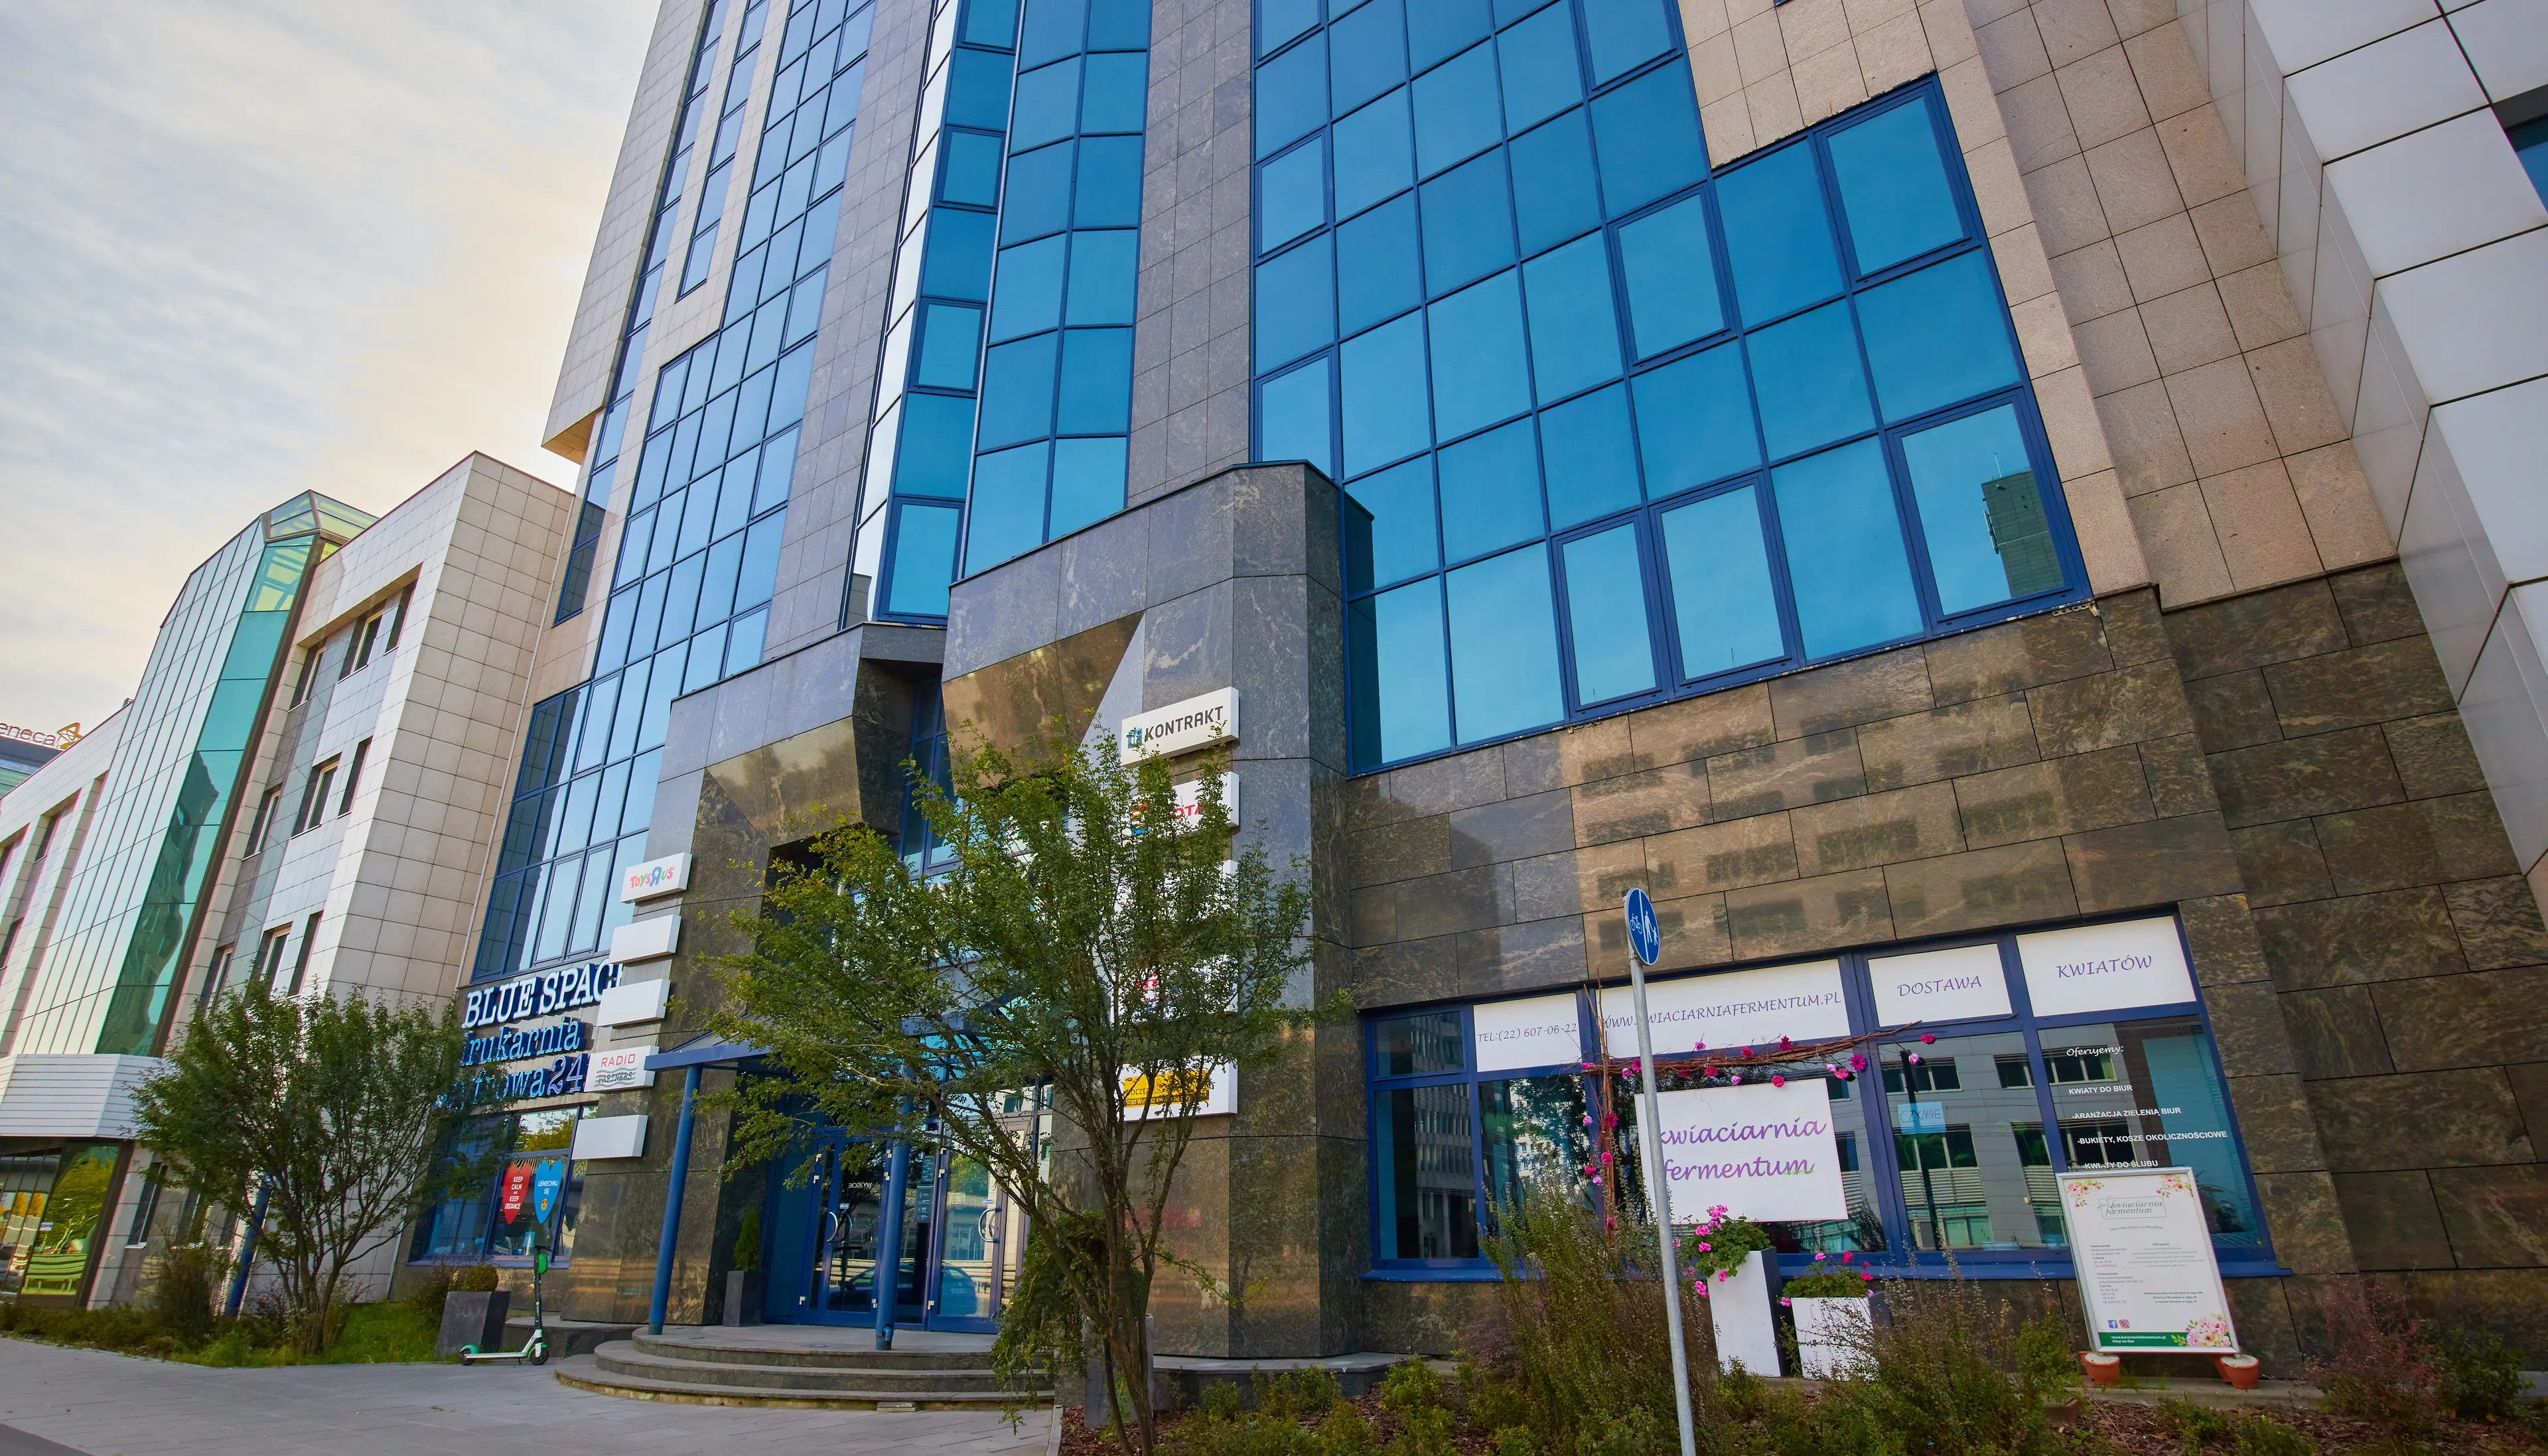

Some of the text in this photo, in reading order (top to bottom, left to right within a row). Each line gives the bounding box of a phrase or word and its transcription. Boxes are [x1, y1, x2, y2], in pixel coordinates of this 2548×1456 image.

[1145, 706, 1224, 741] KONTRAKT
[2056, 955, 2152, 978] KWIATÓW
[462, 958, 623, 1028] BLUE SPAC
[1897, 976, 1983, 996] DOSTAWA
[1524, 1023, 1577, 1037] 607-06-22
[2066, 1045, 2124, 1057] Oferujemy:
[601, 1053, 636, 1067] RADIO
[598, 1072, 633, 1083] PARTNERS
[2072, 1110, 2122, 1119] -ARANŻACJA
[2117, 1134, 2144, 1143] KOSZE
[2145, 1131, 2228, 1141] OKOLICZNOŚCIOWE
[1664, 1156, 1815, 1181] fermentum
[2111, 1199, 2163, 1209] kwiaciarnia
[2105, 1207, 2153, 1218] fermentum
